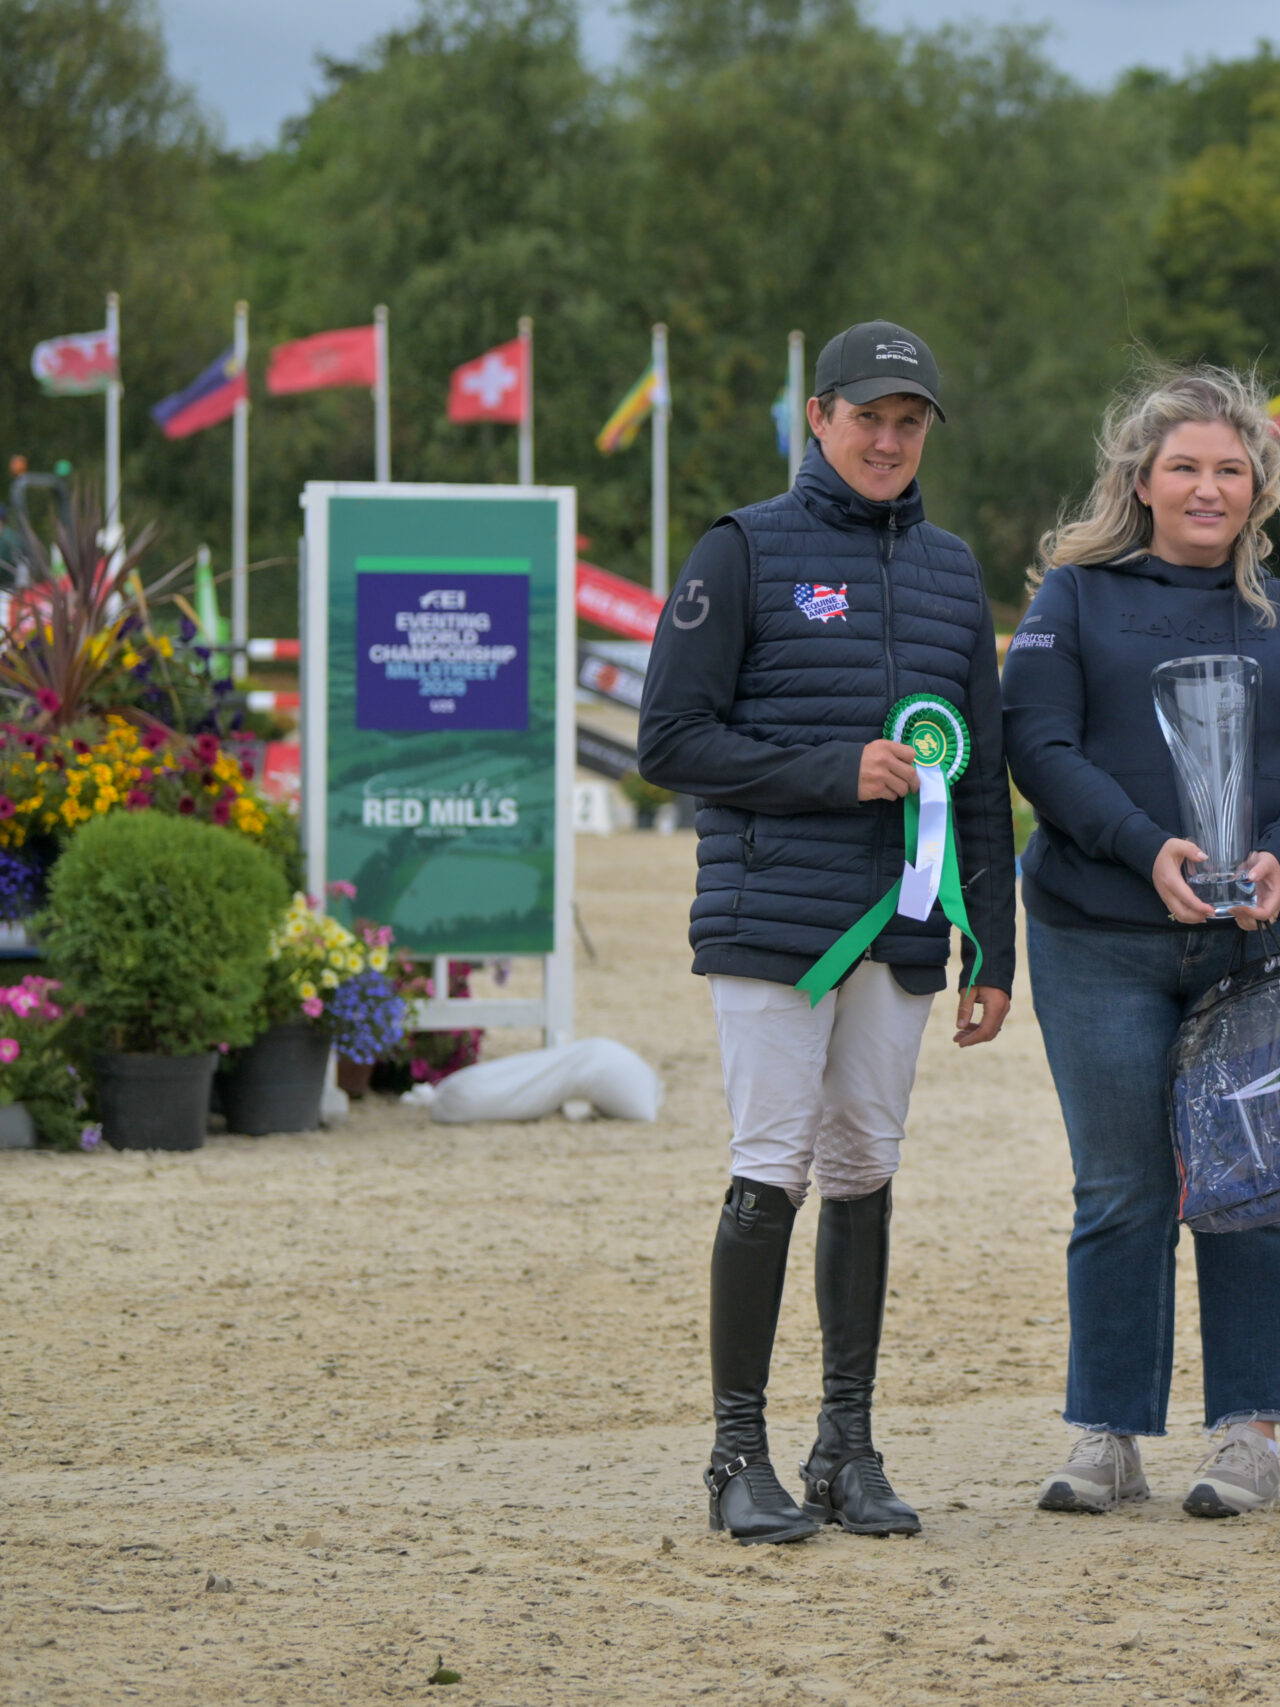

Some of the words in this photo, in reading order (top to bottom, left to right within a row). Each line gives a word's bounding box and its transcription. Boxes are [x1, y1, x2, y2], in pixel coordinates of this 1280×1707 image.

[876, 354, 918, 365] DEFENDER
[804, 596, 837, 612] EQUINE
[809, 601, 848, 618] AMERICA
[395, 612, 491, 632] EVENTING
[408, 630, 479, 647] WORLD
[369, 645, 517, 664] CHAMPIONSHIP
[385, 663, 498, 681] MILLSTREET
[362, 798, 424, 826] RED
[429, 798, 518, 826] MILLS
